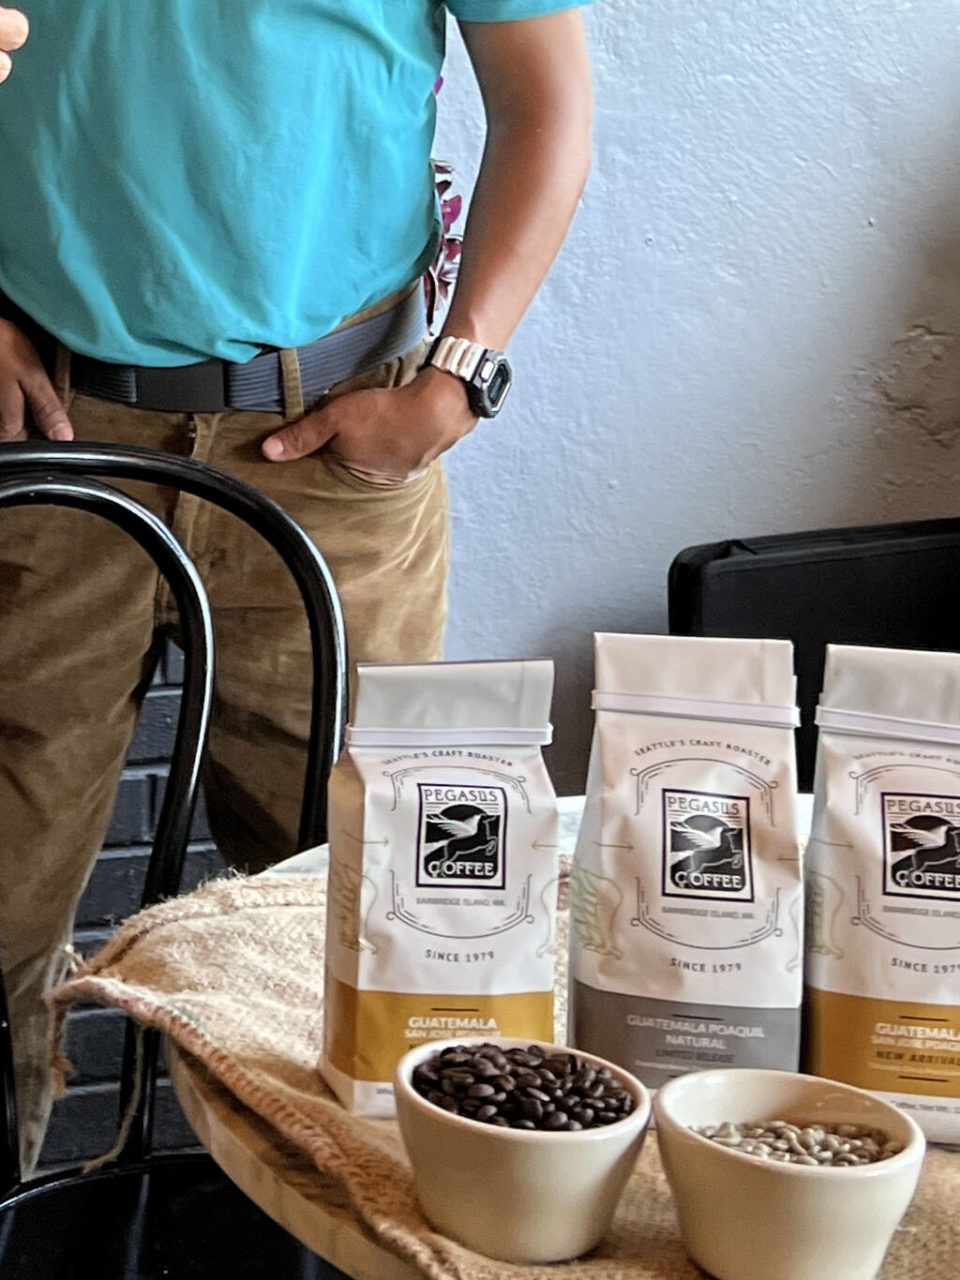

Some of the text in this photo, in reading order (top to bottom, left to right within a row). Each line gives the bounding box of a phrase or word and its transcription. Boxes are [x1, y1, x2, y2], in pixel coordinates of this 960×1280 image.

[467, 751, 513, 767] ROASTER
[633, 739, 771, 767] SEATTLE'S CRAFT ROASTER
[424, 789, 498, 802] PEGASUS
[667, 796, 740, 815] PEGASUS
[427, 861, 495, 877] COFFEE
[674, 871, 743, 888] COFFEE
[425, 949, 494, 962] SINCE 1979
[670, 957, 742, 973] SINCE 1979
[891, 957, 928, 973] SINCE
[408, 1016, 497, 1029] GUATEMALA
[626, 1014, 707, 1034] GUATEMALA
[876, 1022, 960, 1040] GUATEMAL
[665, 1035, 727, 1049] NATURAL
[876, 1051, 904, 1061] NEW
